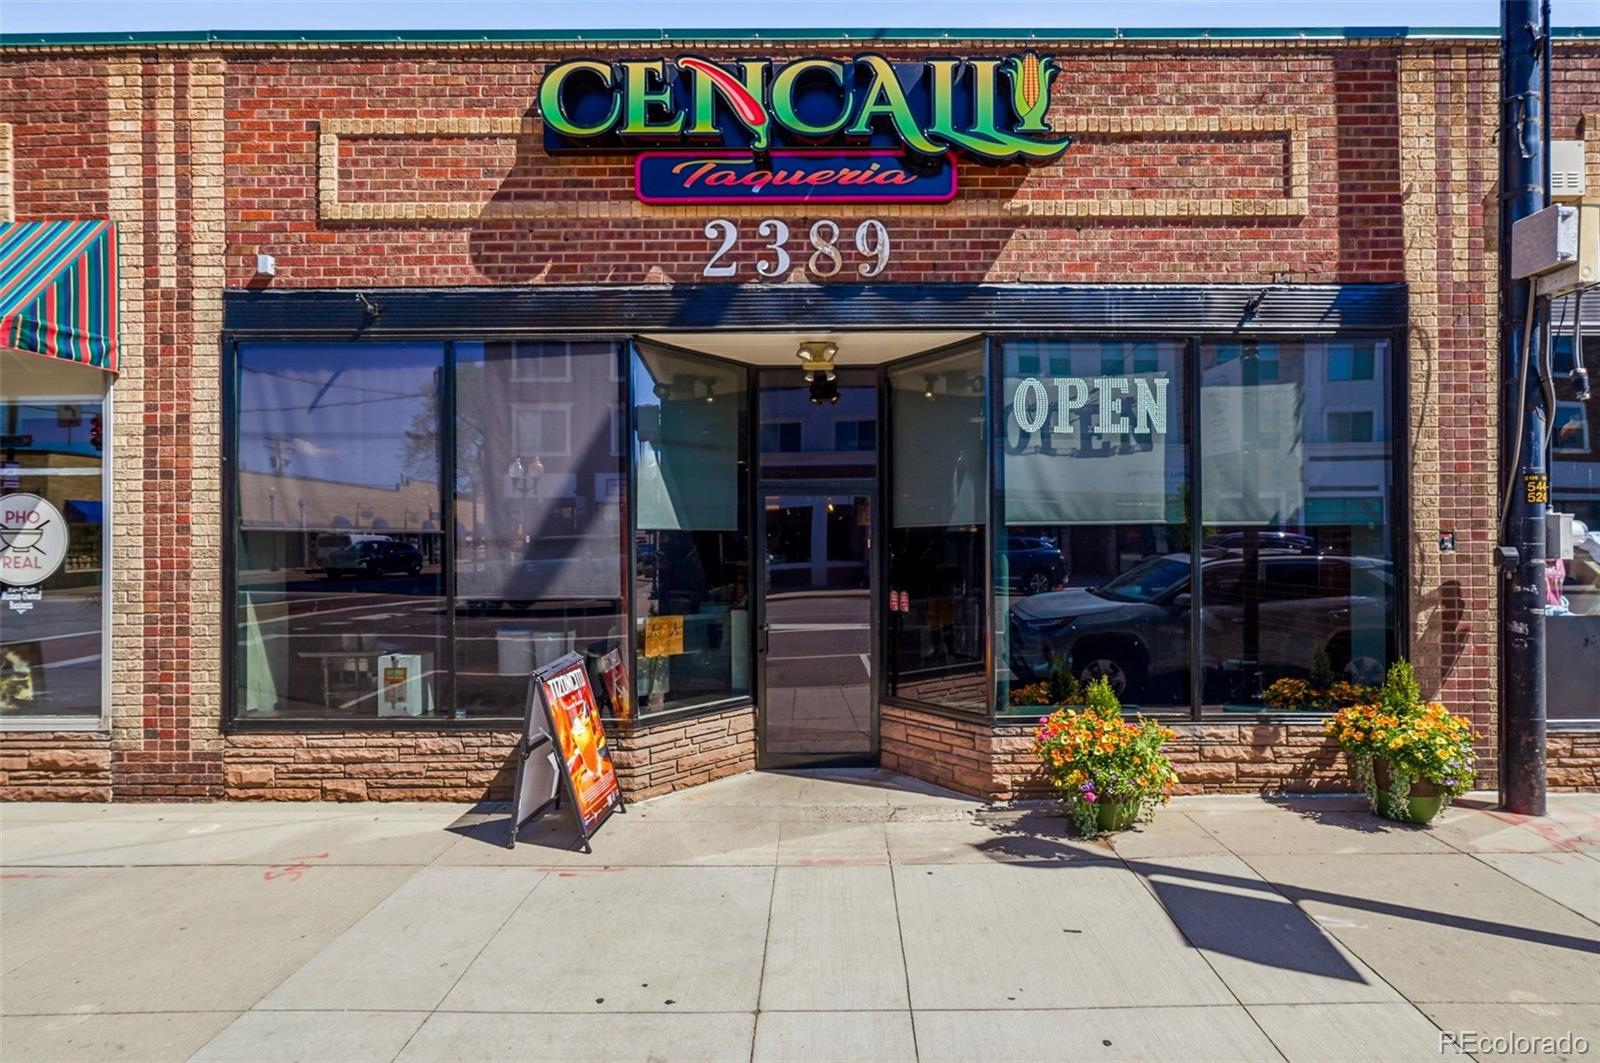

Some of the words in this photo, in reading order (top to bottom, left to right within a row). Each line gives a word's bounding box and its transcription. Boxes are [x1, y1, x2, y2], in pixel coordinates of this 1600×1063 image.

[671, 159, 918, 193] Taqueria
[703, 219, 890, 277] 2389
[1013, 377, 1170, 434] OPEN
[5, 510, 40, 524] PHO
[2, 556, 42, 569] REAL
